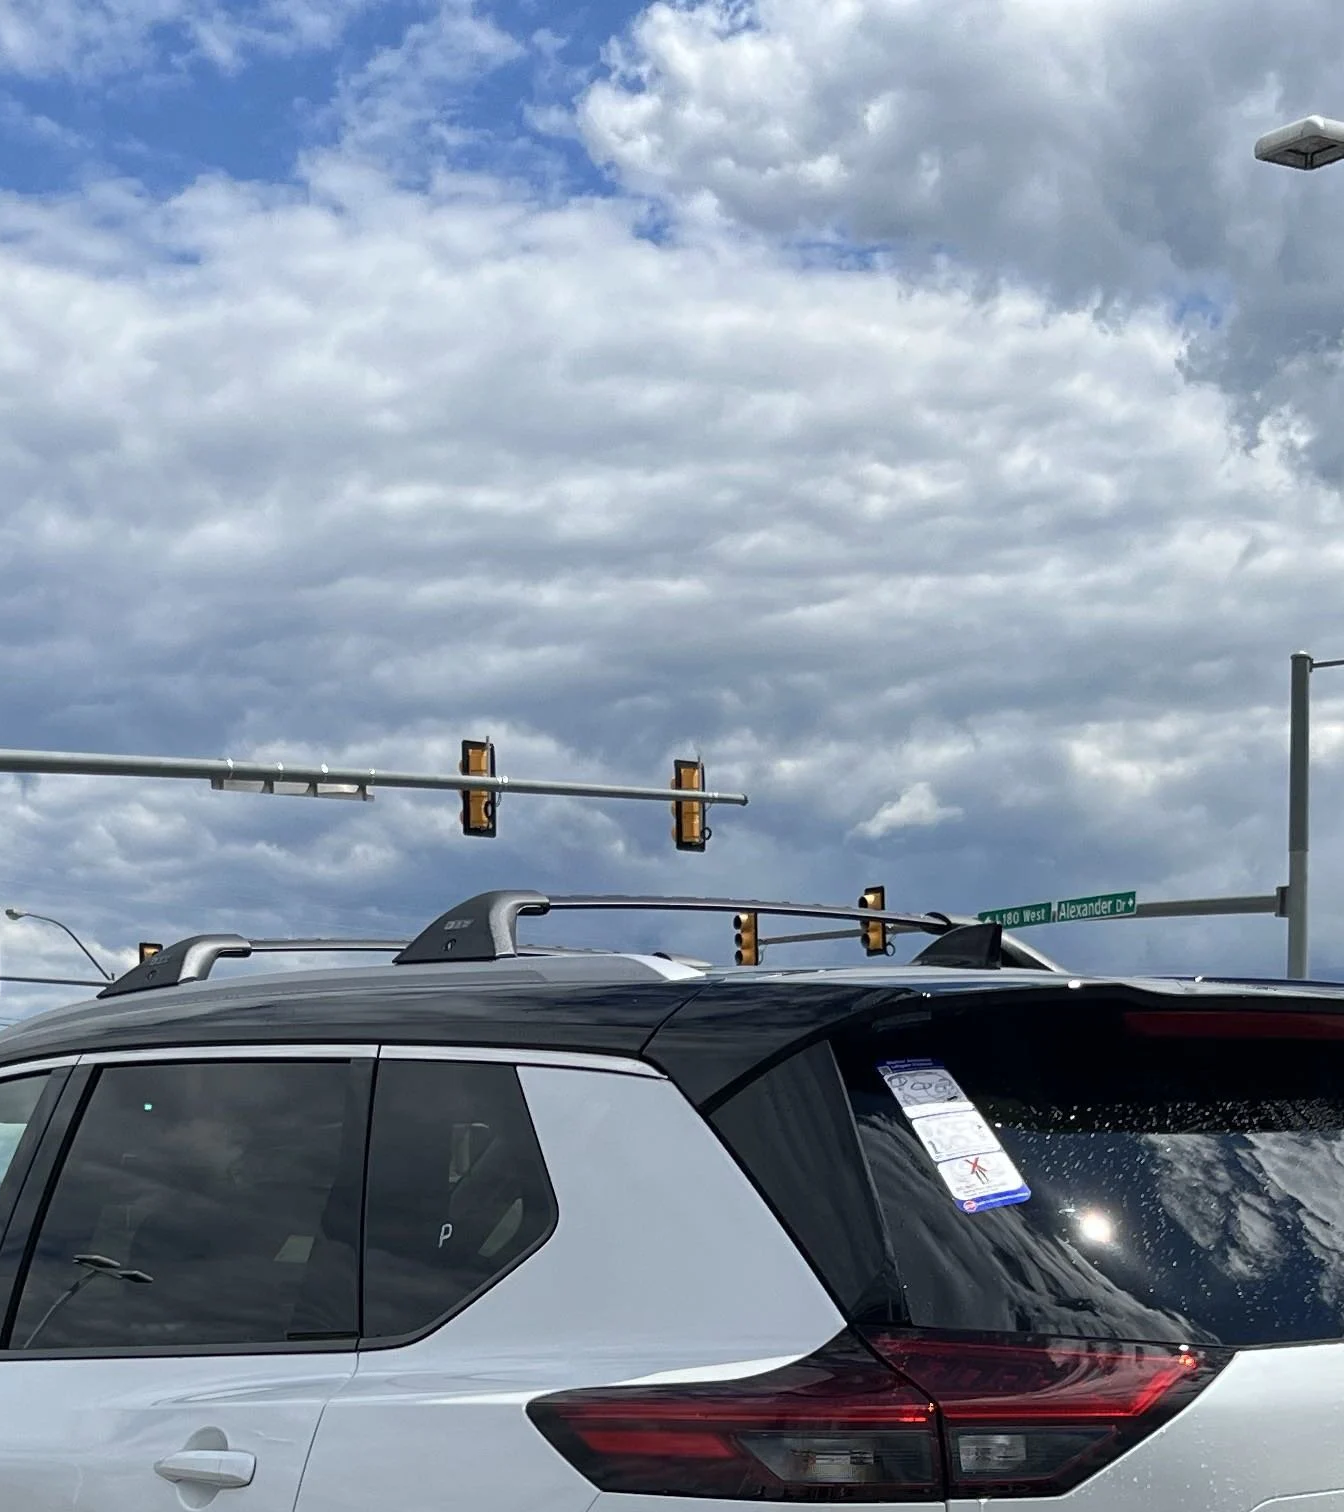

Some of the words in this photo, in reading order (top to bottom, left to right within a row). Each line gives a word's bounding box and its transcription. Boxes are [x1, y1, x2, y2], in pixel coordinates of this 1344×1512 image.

[1023, 908, 1045, 922] West
[1059, 898, 1112, 920] Alexander
[1116, 898, 1126, 912] Dr
